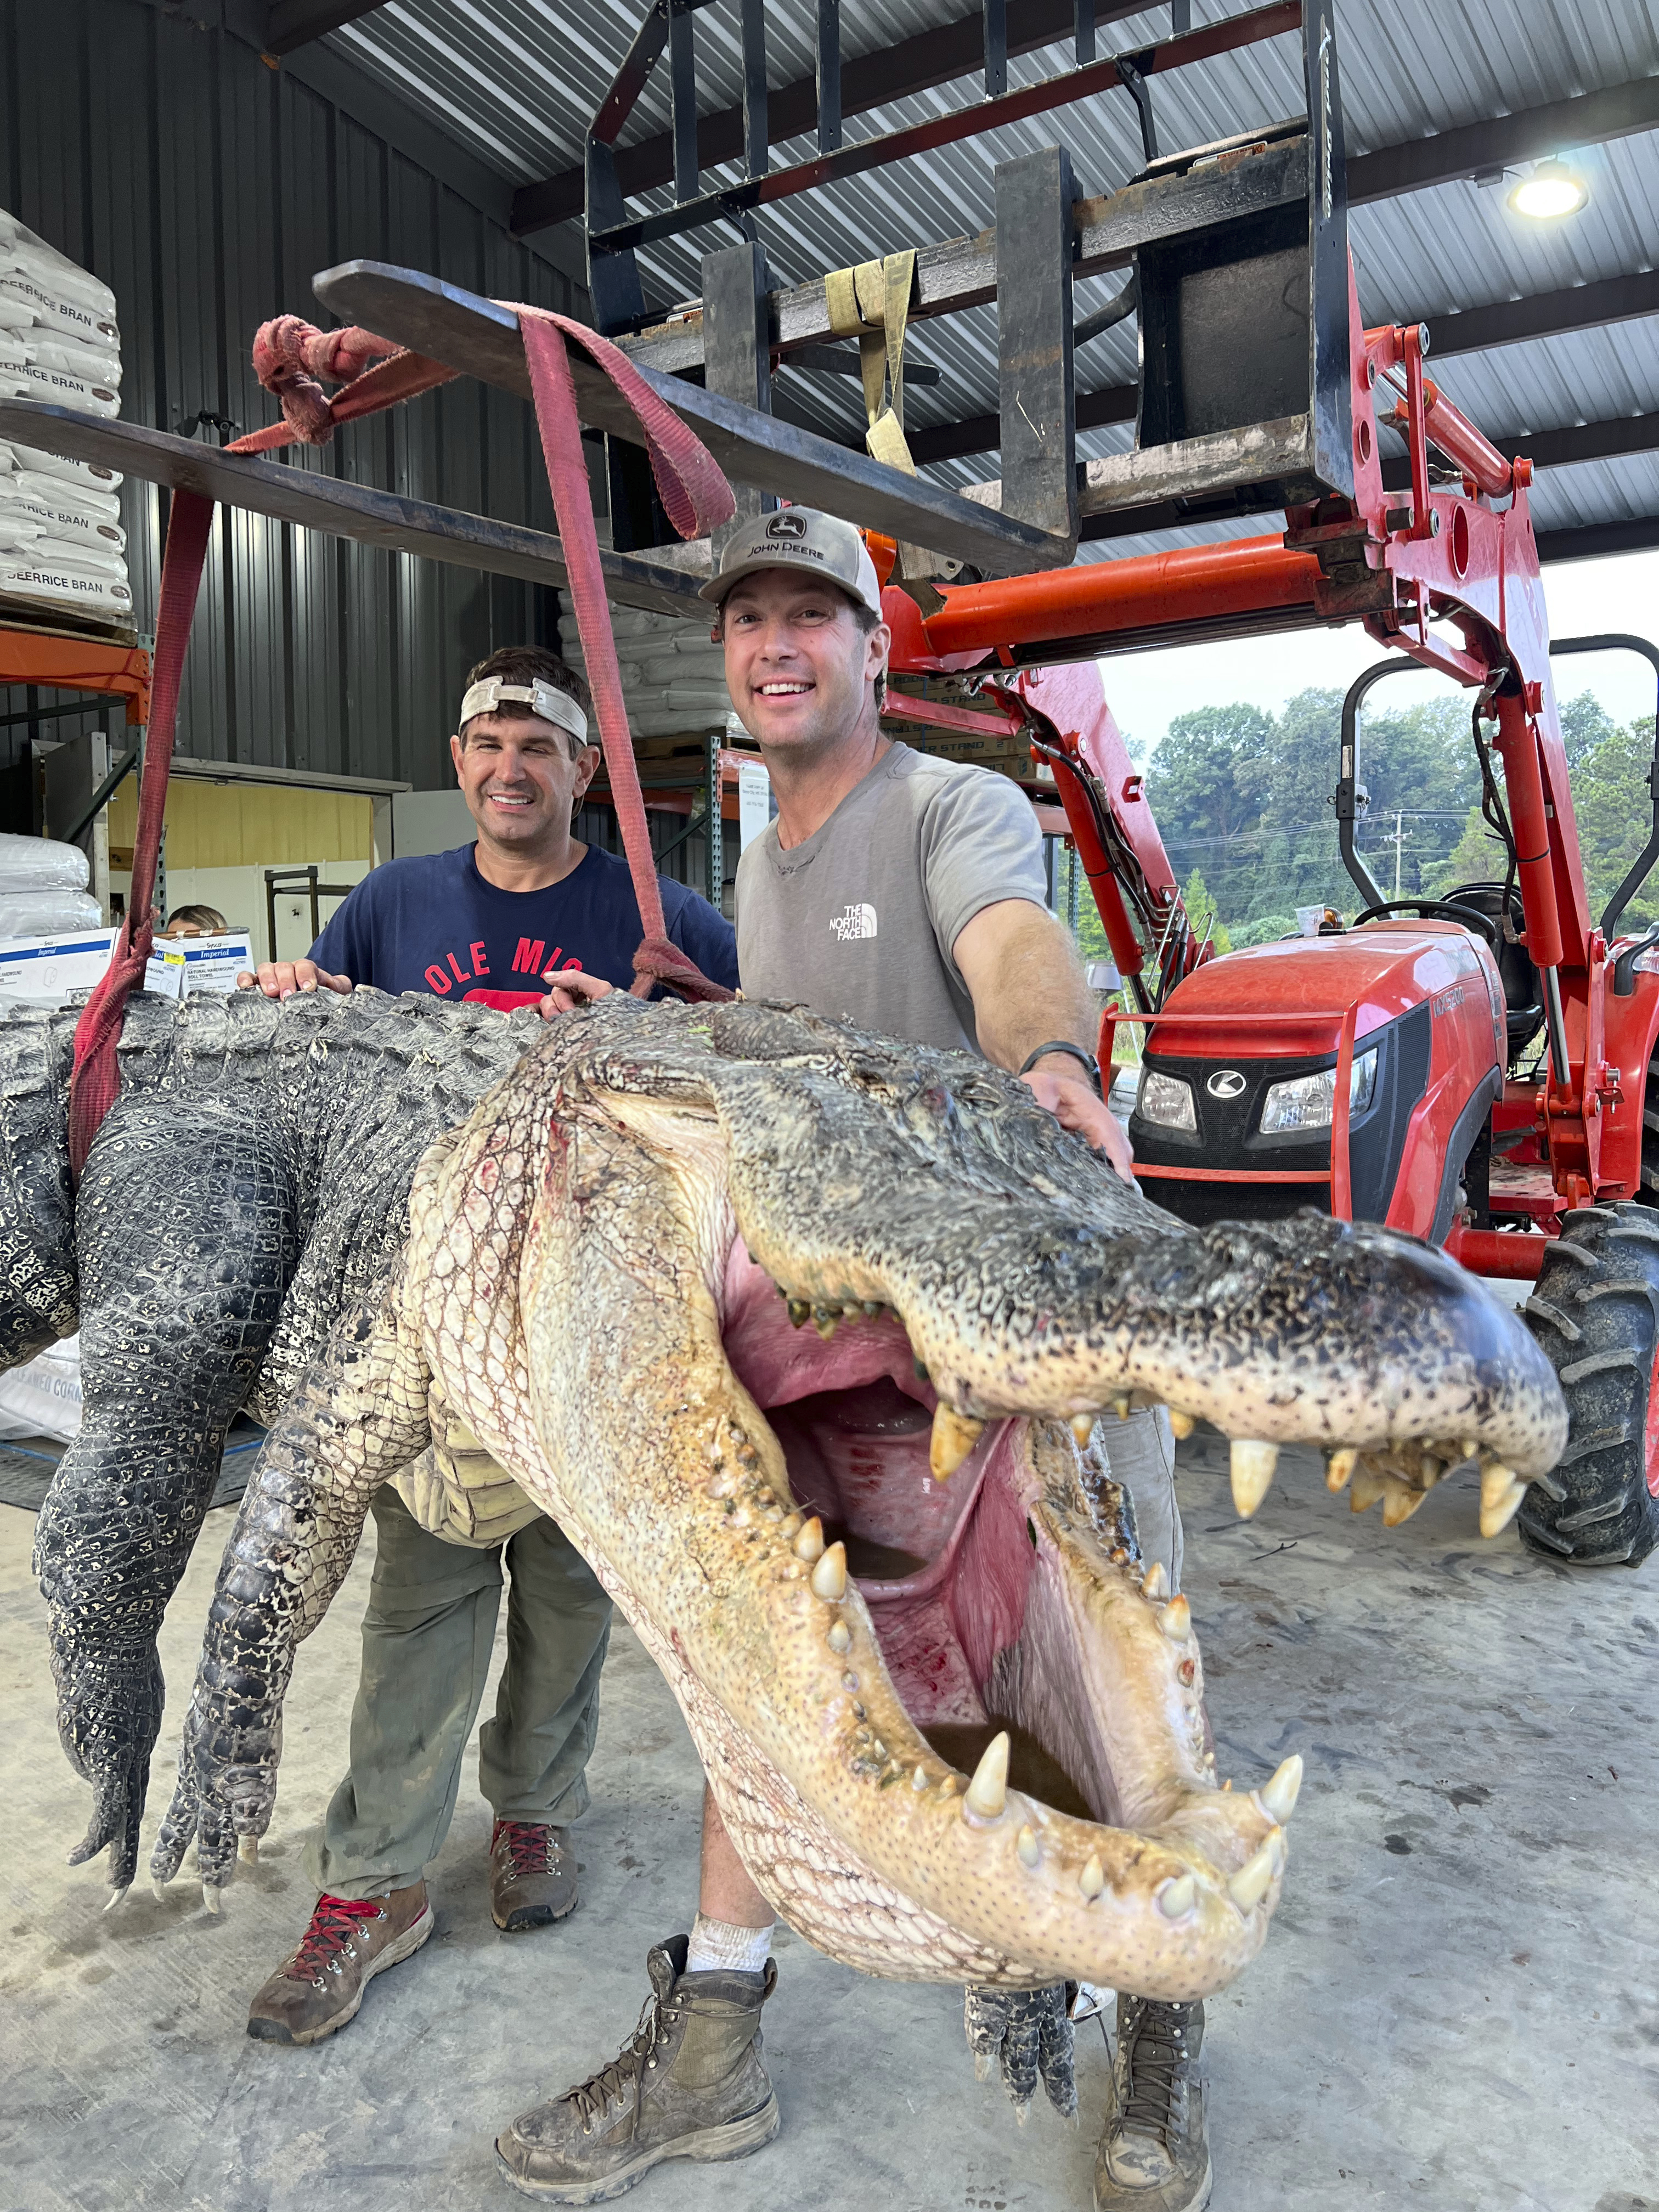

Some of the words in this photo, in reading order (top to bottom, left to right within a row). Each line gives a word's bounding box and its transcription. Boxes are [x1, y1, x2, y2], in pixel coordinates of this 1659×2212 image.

[60, 304, 91, 326] BRAN
[51, 375, 84, 392] BRAN
[747, 543, 779, 558] JOHN
[782, 542, 825, 561] DEERE
[72, 579, 103, 594] BRAN
[940, 741, 985, 752] STAND
[844, 904, 861, 917] THE
[829, 915, 861, 931] NORTH
[837, 927, 861, 941] FACE
[200, 948, 229, 959] Imperial
[424, 940, 490, 995] OLE
[1432, 986, 1465, 1019] MX5200
[54, 1378, 83, 1403] CORN
